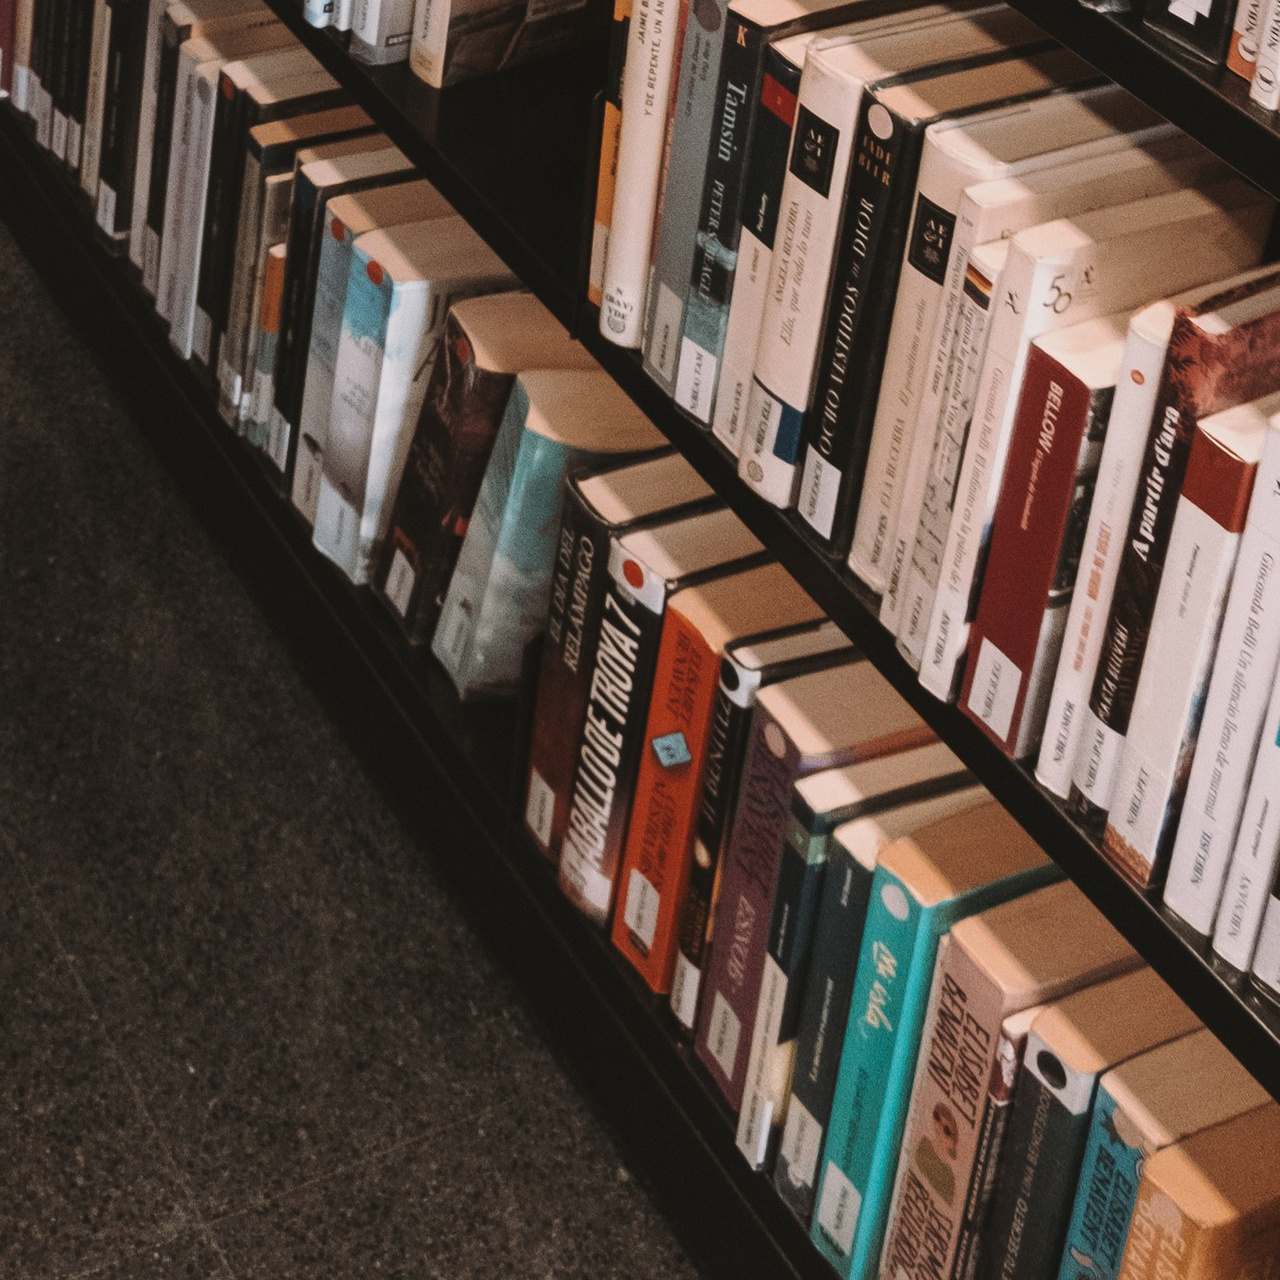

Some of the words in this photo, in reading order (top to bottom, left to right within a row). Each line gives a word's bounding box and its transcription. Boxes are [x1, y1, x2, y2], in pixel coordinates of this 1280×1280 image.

[639, 12, 651, 44] JAIME
[735, 24, 746, 47] K
[648, 38, 661, 90] REPENTE,
[717, 80, 748, 163] Tamsin
[782, 200, 800, 258] BECERRA
[852, 196, 876, 263] DIOR
[830, 286, 860, 389] VESTIDOS
[820, 392, 842, 456] OCHO
[1040, 379, 1065, 454] BELLOW
[1153, 403, 1180, 468] d'ara
[1139, 472, 1162, 535] partir
[1131, 538, 1150, 563] A
[1250, 552, 1275, 614] Gioconda
[605, 592, 642, 637] 7
[591, 618, 639, 725] TROYA
[1228, 670, 1247, 717] silencio
[1052, 700, 1075, 765] N(BEL)MOR
[1084, 730, 1105, 791] N(BEL)PAR
[1126, 766, 1147, 828] N(BEL)PET
[928, 973, 967, 1086] BENAVENT
